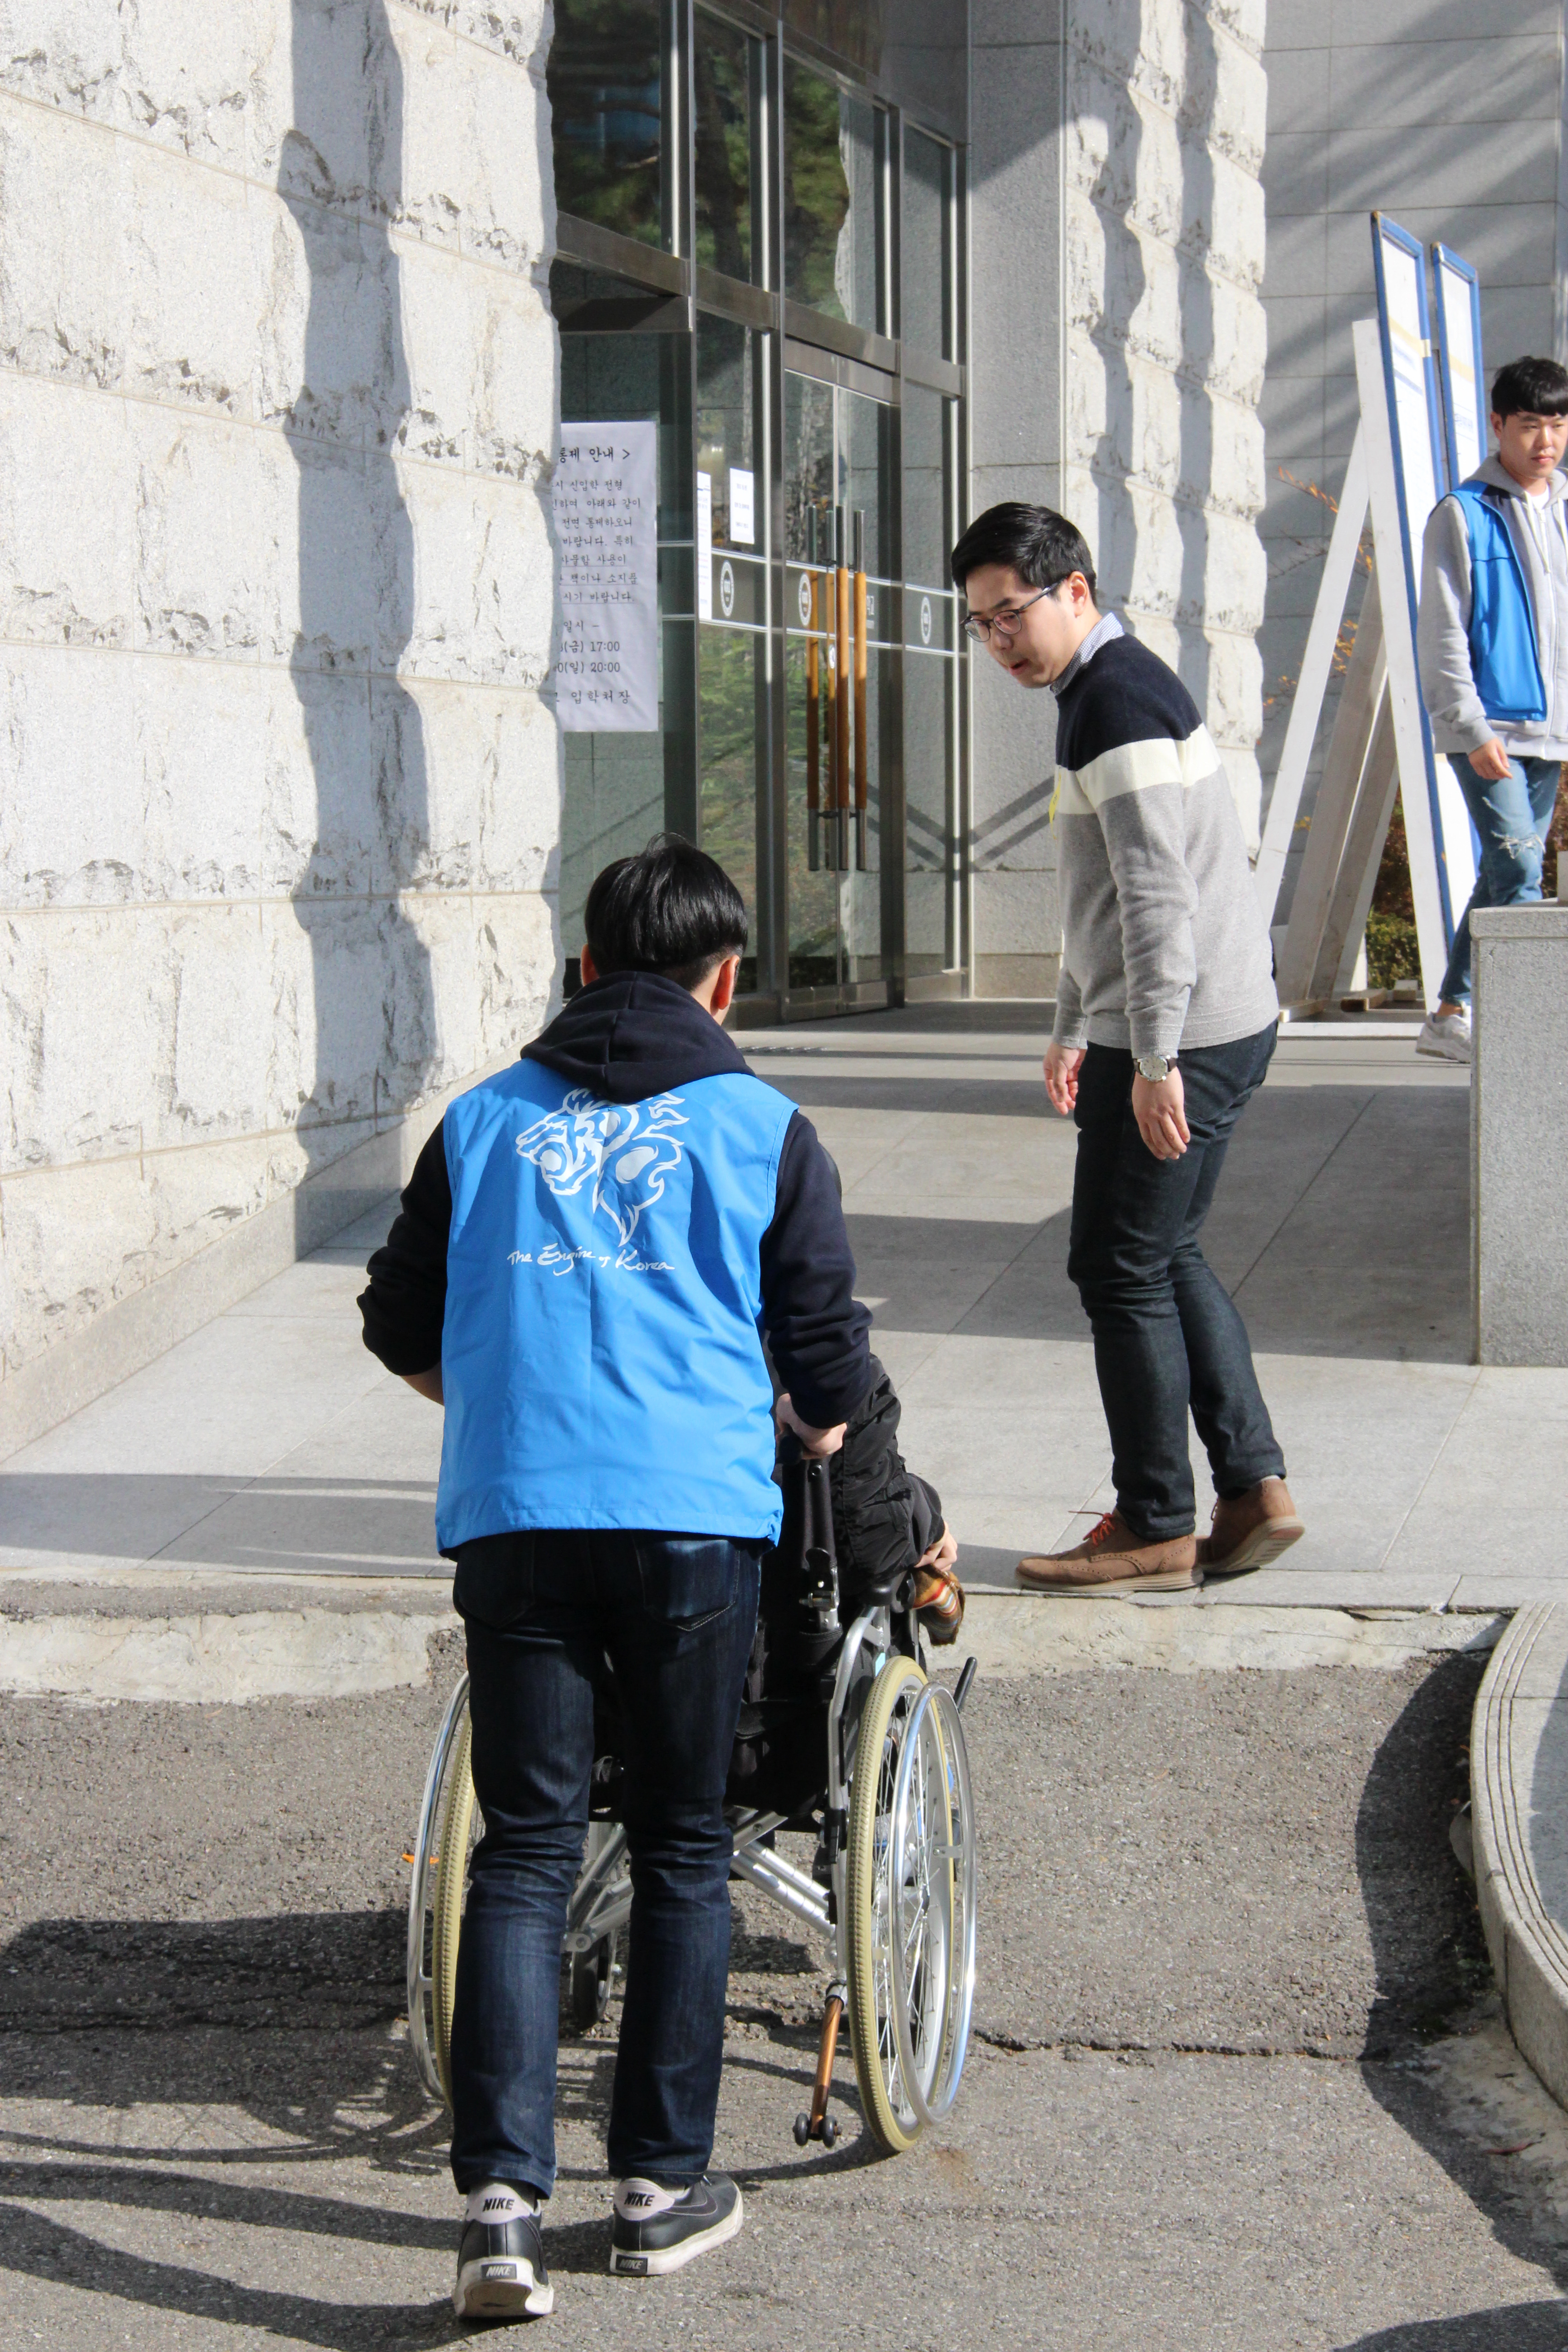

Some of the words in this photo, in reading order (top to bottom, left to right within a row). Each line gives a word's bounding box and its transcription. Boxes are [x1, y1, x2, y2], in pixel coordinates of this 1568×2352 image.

[589, 446, 614, 462] 안내
[552, 480, 564, 491] 시
[570, 480, 599, 492] 신입학
[605, 480, 623, 491] 전형
[587, 498, 617, 510] 아래와
[622, 497, 641, 510] 같이
[562, 517, 579, 529] 전면
[586, 517, 632, 529] 통제하오니
[614, 535, 633, 547] 특히
[597, 554, 626, 566] 사용이
[570, 573, 601, 584] 책이나
[607, 573, 637, 584] 소지품
[564, 620, 584, 632] 일시
[590, 641, 620, 652] 17:00
[590, 662, 620, 673] 20:00
[507, 1250, 533, 1266] The
[537, 1242, 596, 1276] Engine
[615, 1249, 675, 1271] Korea
[482, 2197, 514, 2212] NIKE
[624, 2191, 655, 2207] NIKE
[619, 2258, 643, 2270] NIKE
[486, 2265, 512, 2278] NIKE
